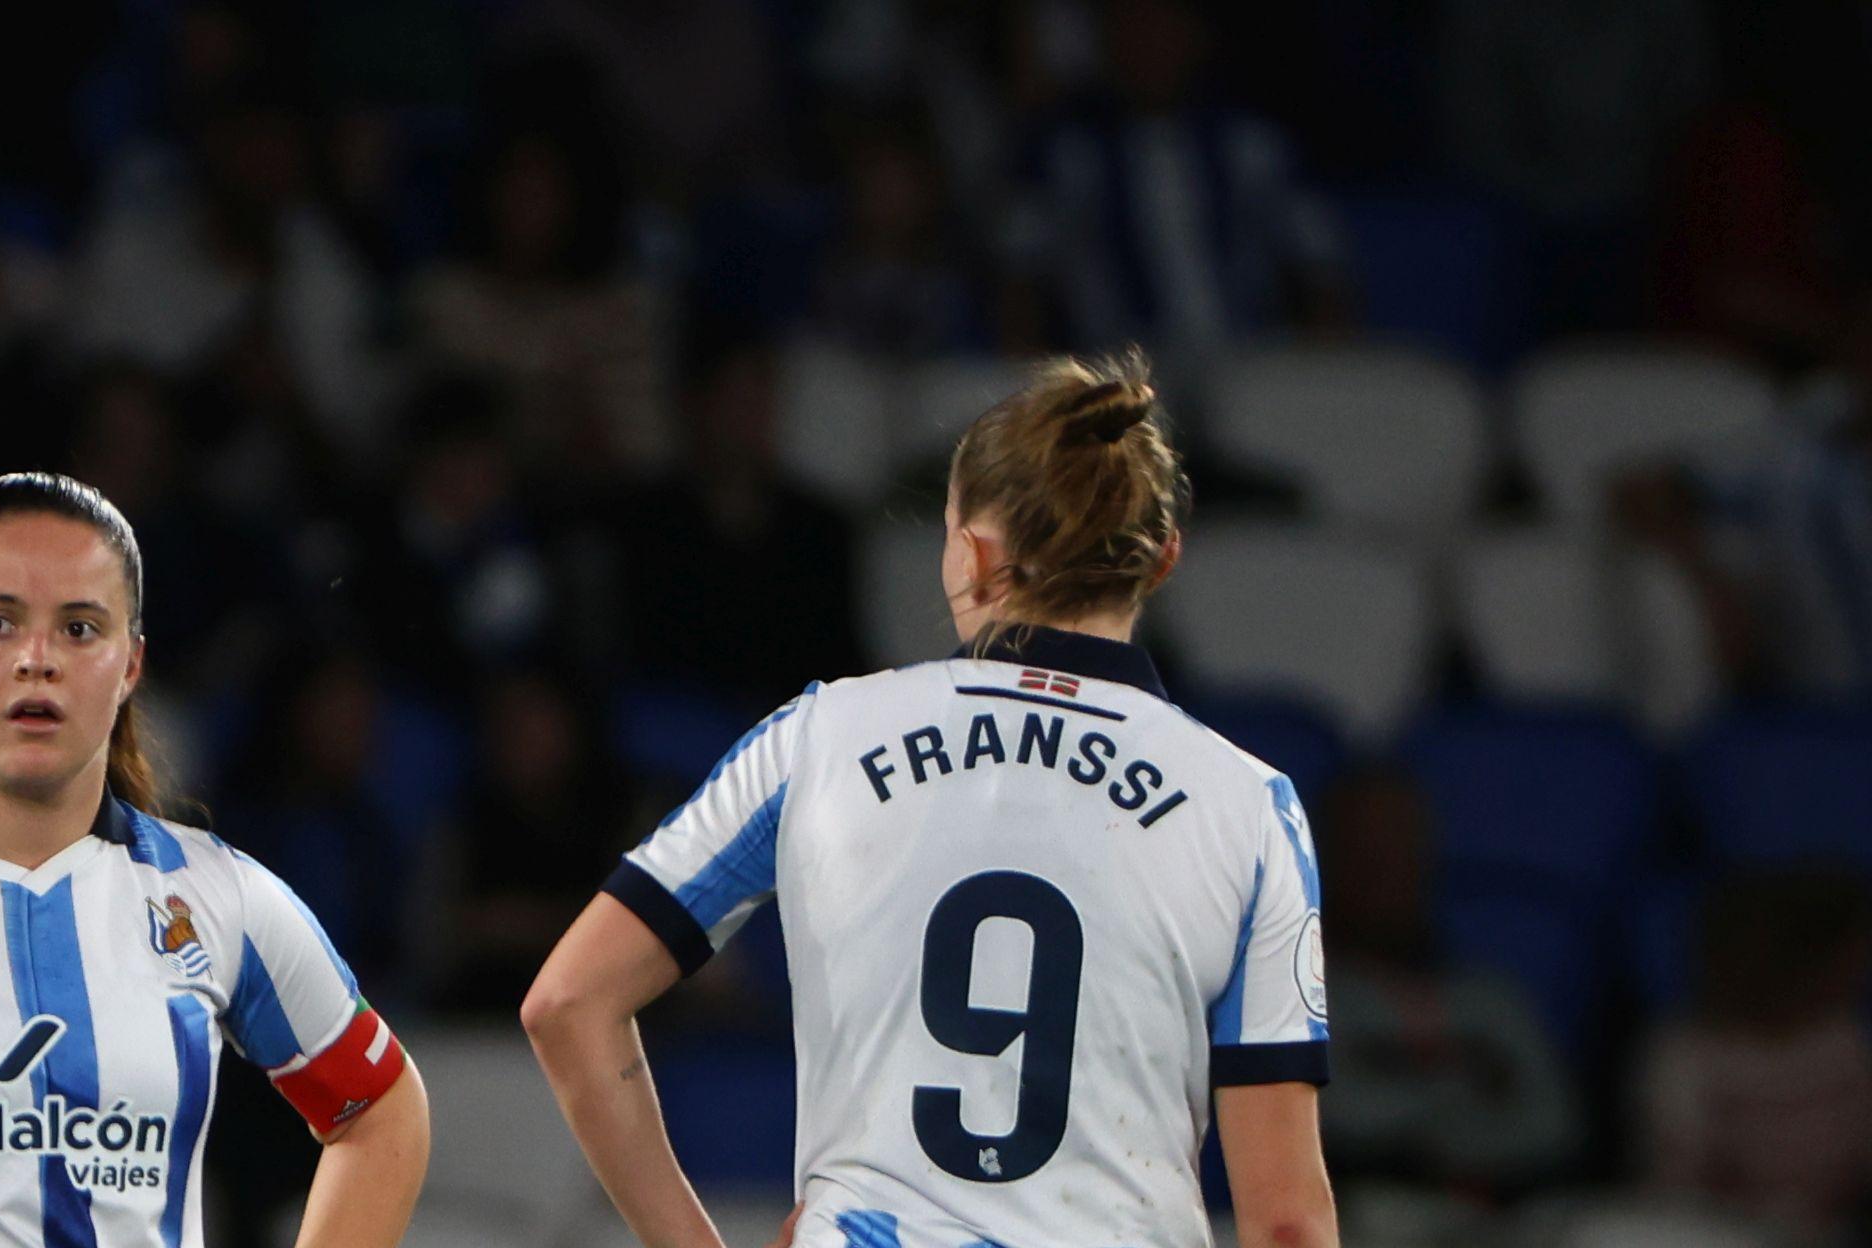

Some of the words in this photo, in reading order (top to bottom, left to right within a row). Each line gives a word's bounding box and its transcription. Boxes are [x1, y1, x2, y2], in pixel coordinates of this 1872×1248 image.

[859, 712, 1189, 829] FRANSSI
[911, 868, 1084, 1183] 9
[70, 1156, 161, 1192] viajes
